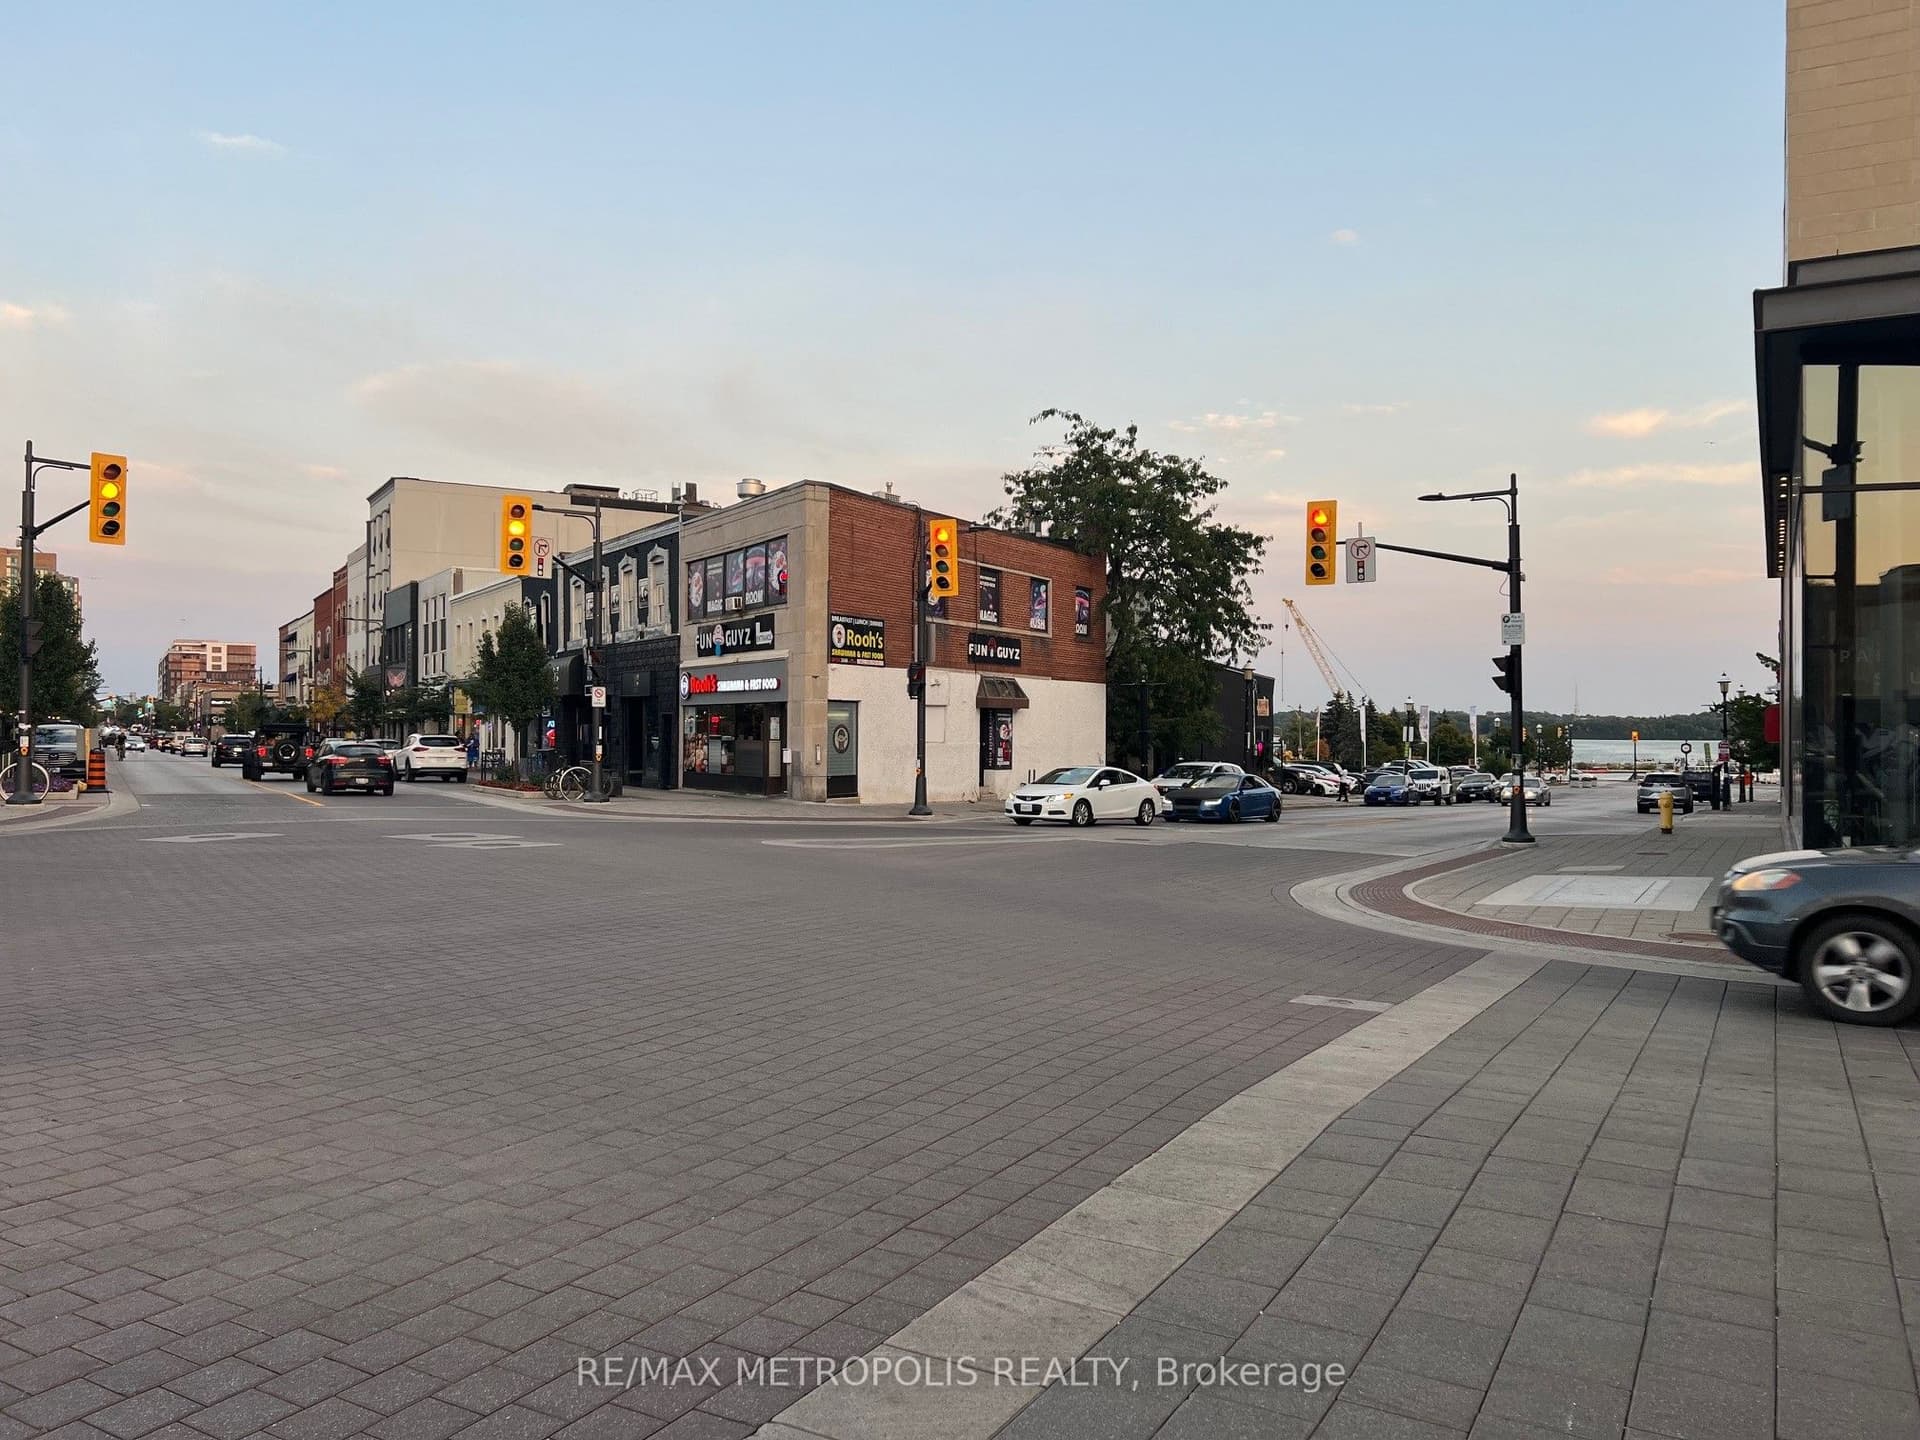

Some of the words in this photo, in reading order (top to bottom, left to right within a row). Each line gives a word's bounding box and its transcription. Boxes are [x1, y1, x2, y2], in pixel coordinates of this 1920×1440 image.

[696, 632, 712, 649] FUN
[725, 628, 751, 647] GUYZ
[847, 629, 884, 649] Rooh's
[968, 643, 988, 657] FUN
[997, 646, 1021, 660] GUYZ
[762, 678, 778, 690] FOOD
